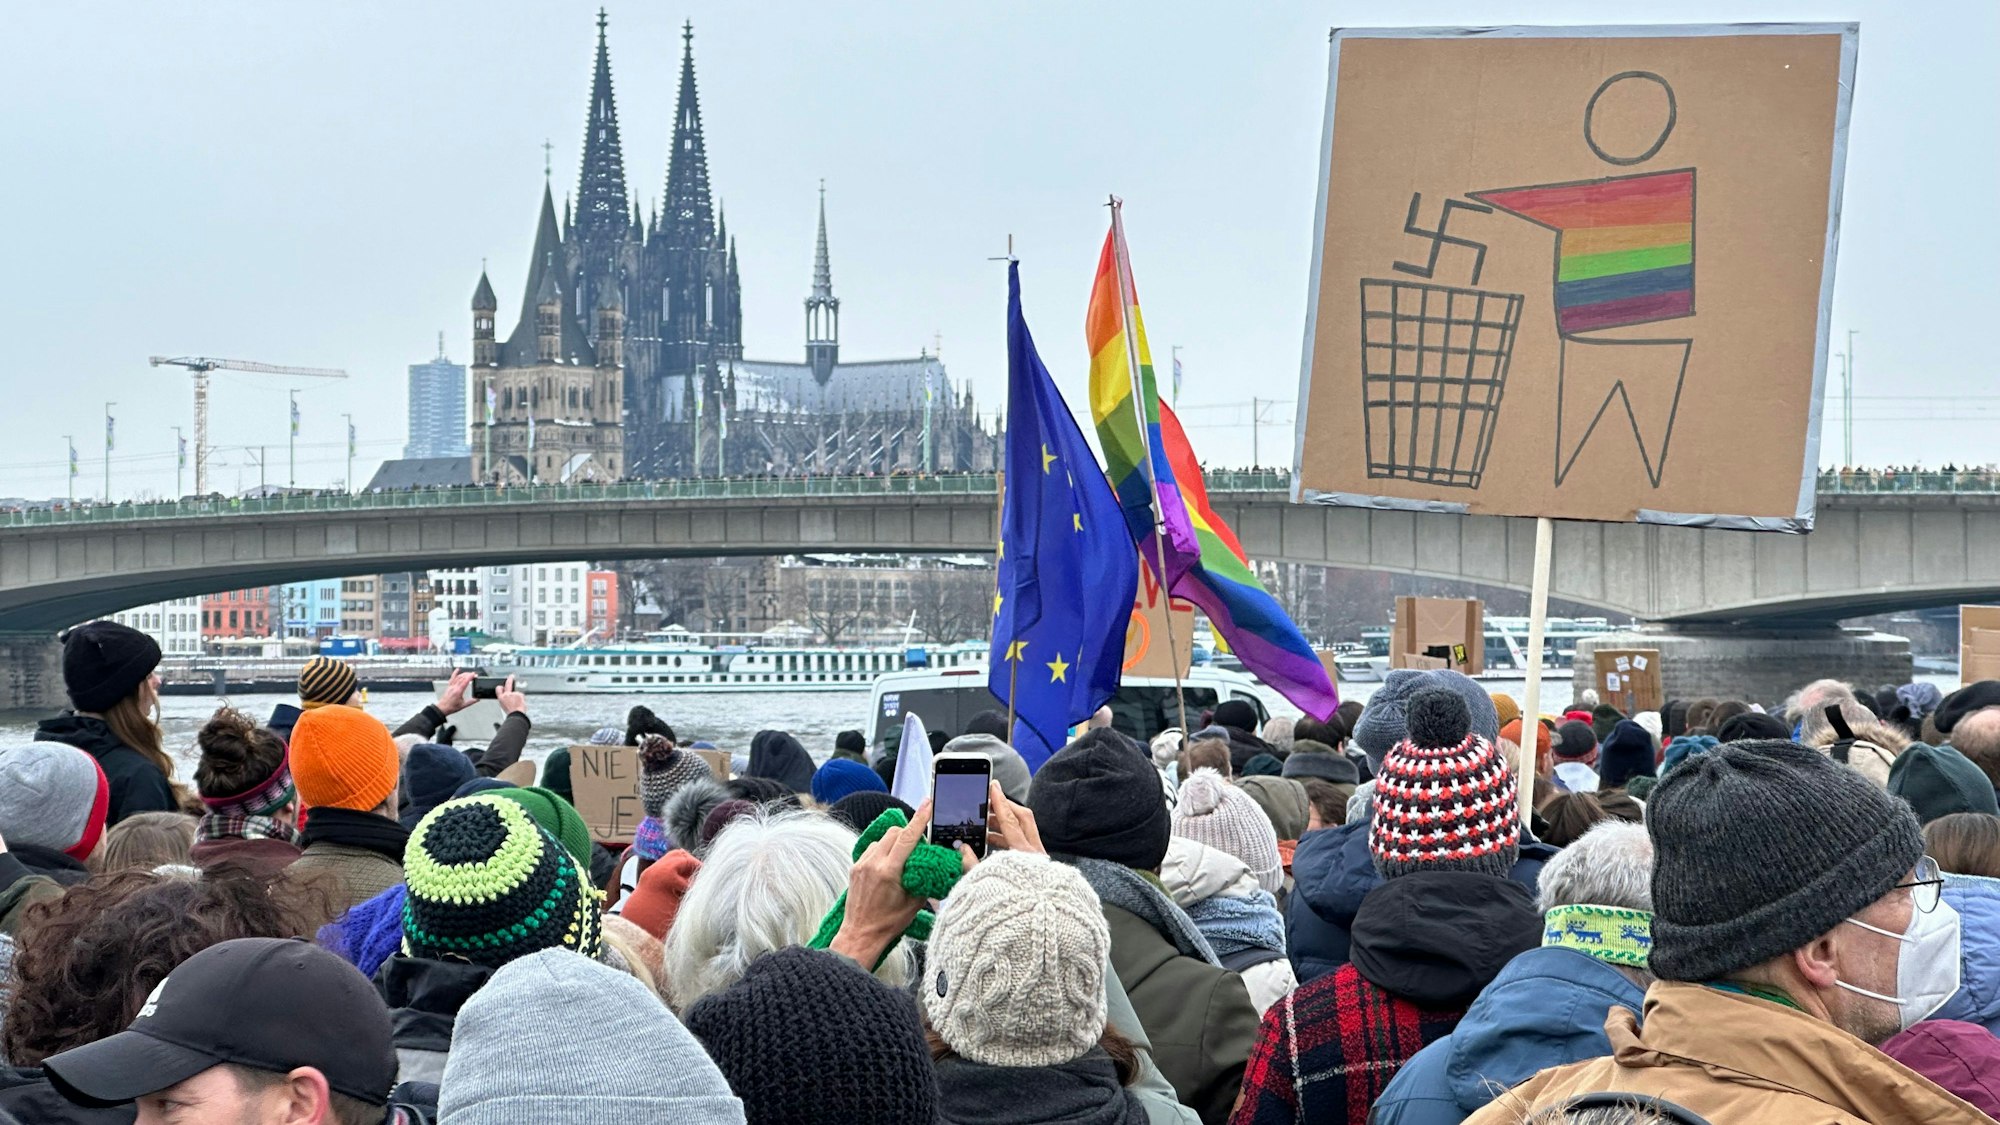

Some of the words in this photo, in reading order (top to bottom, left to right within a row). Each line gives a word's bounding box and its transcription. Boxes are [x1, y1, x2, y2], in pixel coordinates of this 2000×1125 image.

[883, 694, 900, 702] NRW
[582, 749, 627, 780] NIE
[594, 796, 638, 839] JE
